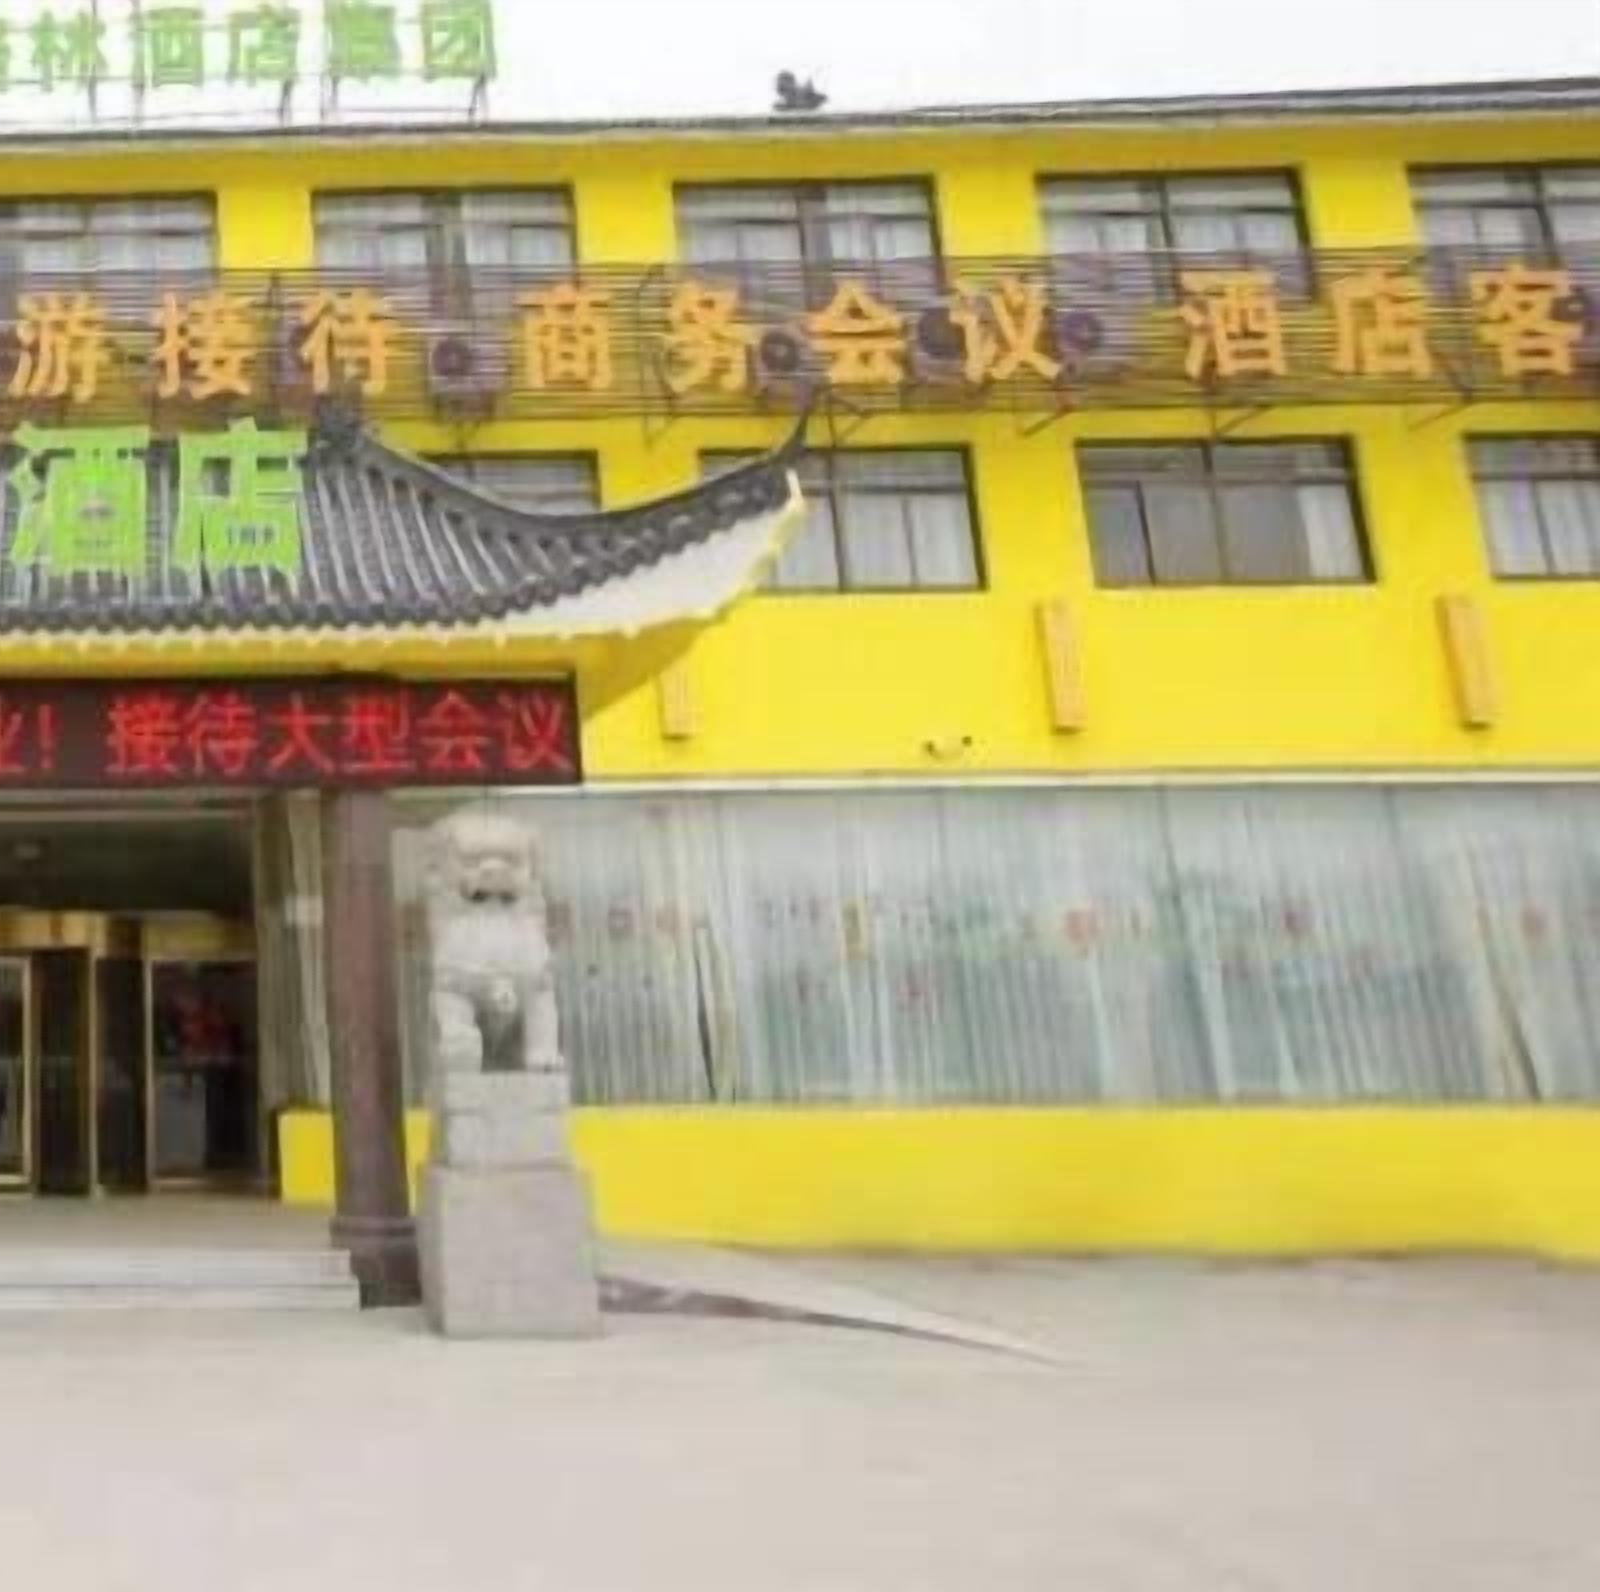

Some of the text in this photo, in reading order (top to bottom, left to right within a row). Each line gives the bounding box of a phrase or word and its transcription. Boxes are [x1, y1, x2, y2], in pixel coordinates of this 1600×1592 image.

[515, 280, 1062, 390] 商务会议
[1178, 260, 1583, 378] 酒店客
